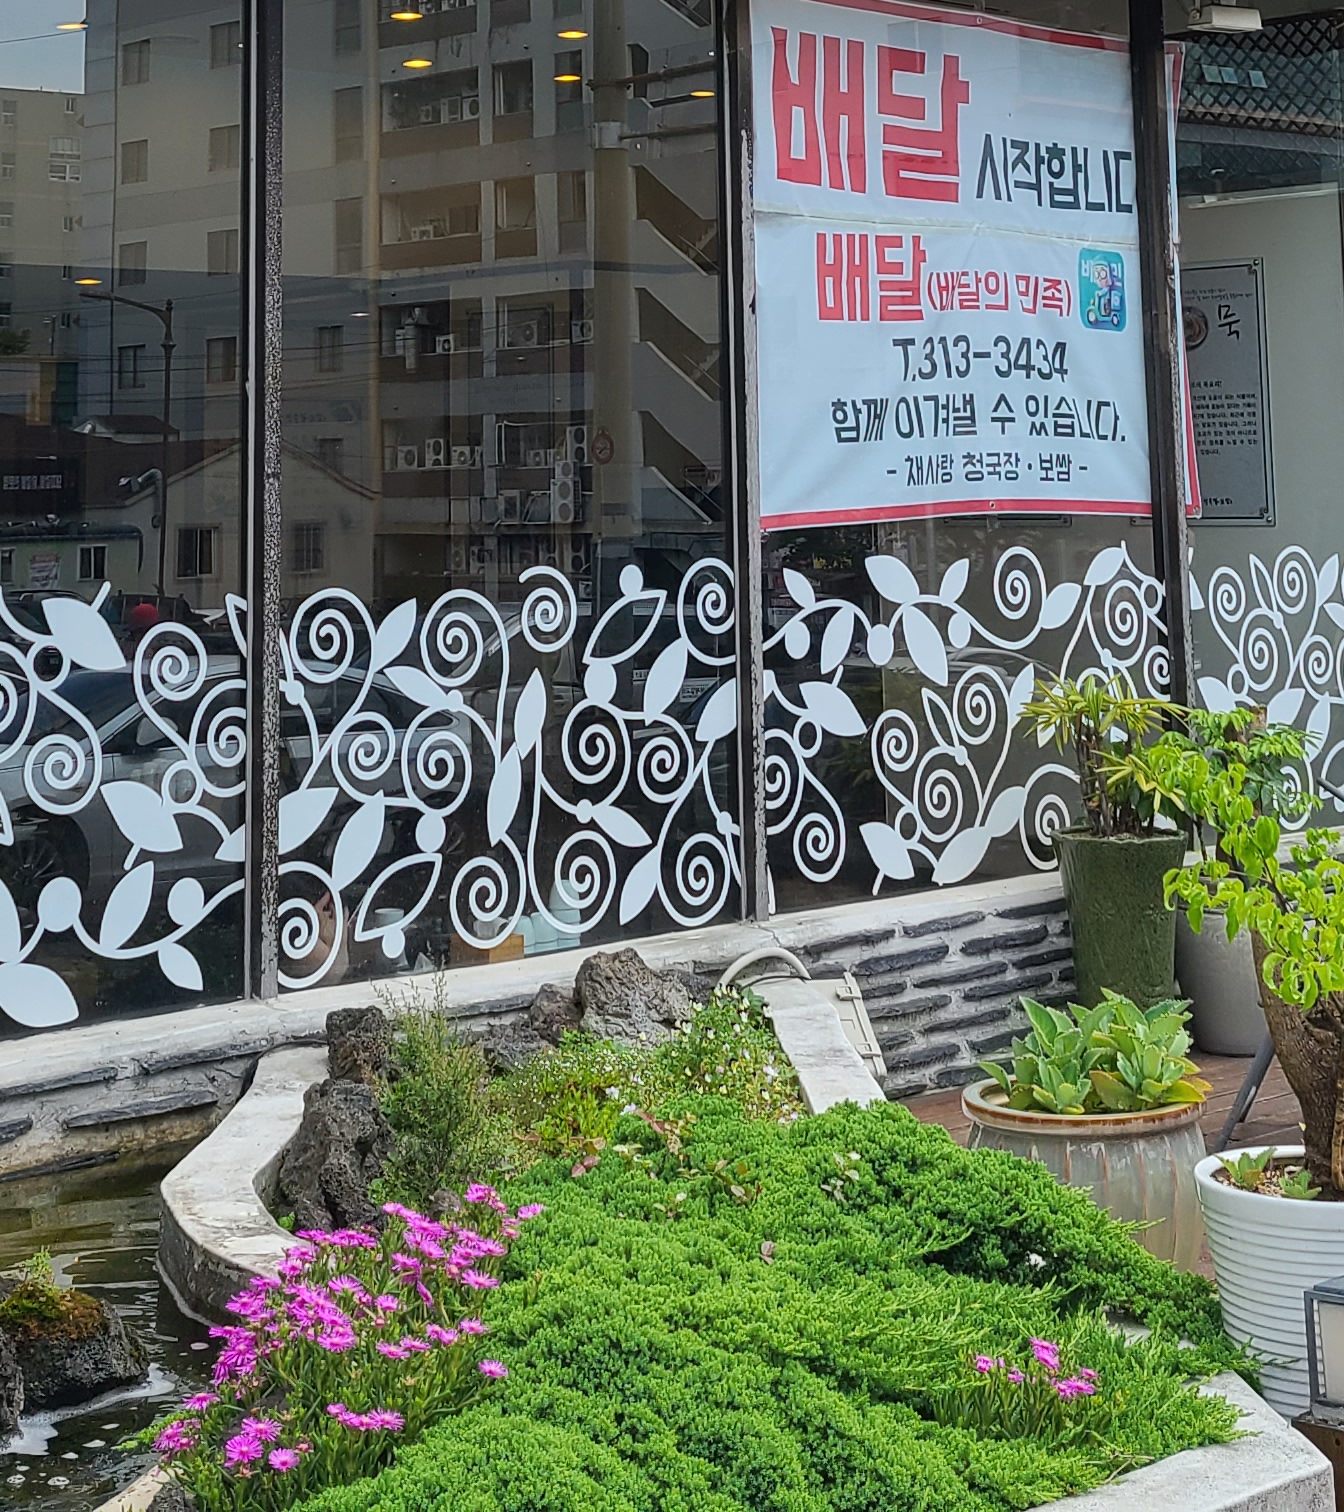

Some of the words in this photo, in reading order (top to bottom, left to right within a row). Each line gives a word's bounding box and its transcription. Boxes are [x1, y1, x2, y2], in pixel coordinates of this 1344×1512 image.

[770, 26, 971, 204] 배달
[816, 233, 927, 322] 배달
[927, 271, 1009, 311] (배달의
[1014, 274, 1072, 317] 민족)
[892, 334, 1069, 382] T.313-3434
[831, 397, 889, 443] 함께
[894, 393, 978, 439] 이겨낼
[990, 393, 1016, 436] 수
[1025, 394, 1126, 442] 있습니다.
[904, 453, 954, 486] 채사랑
